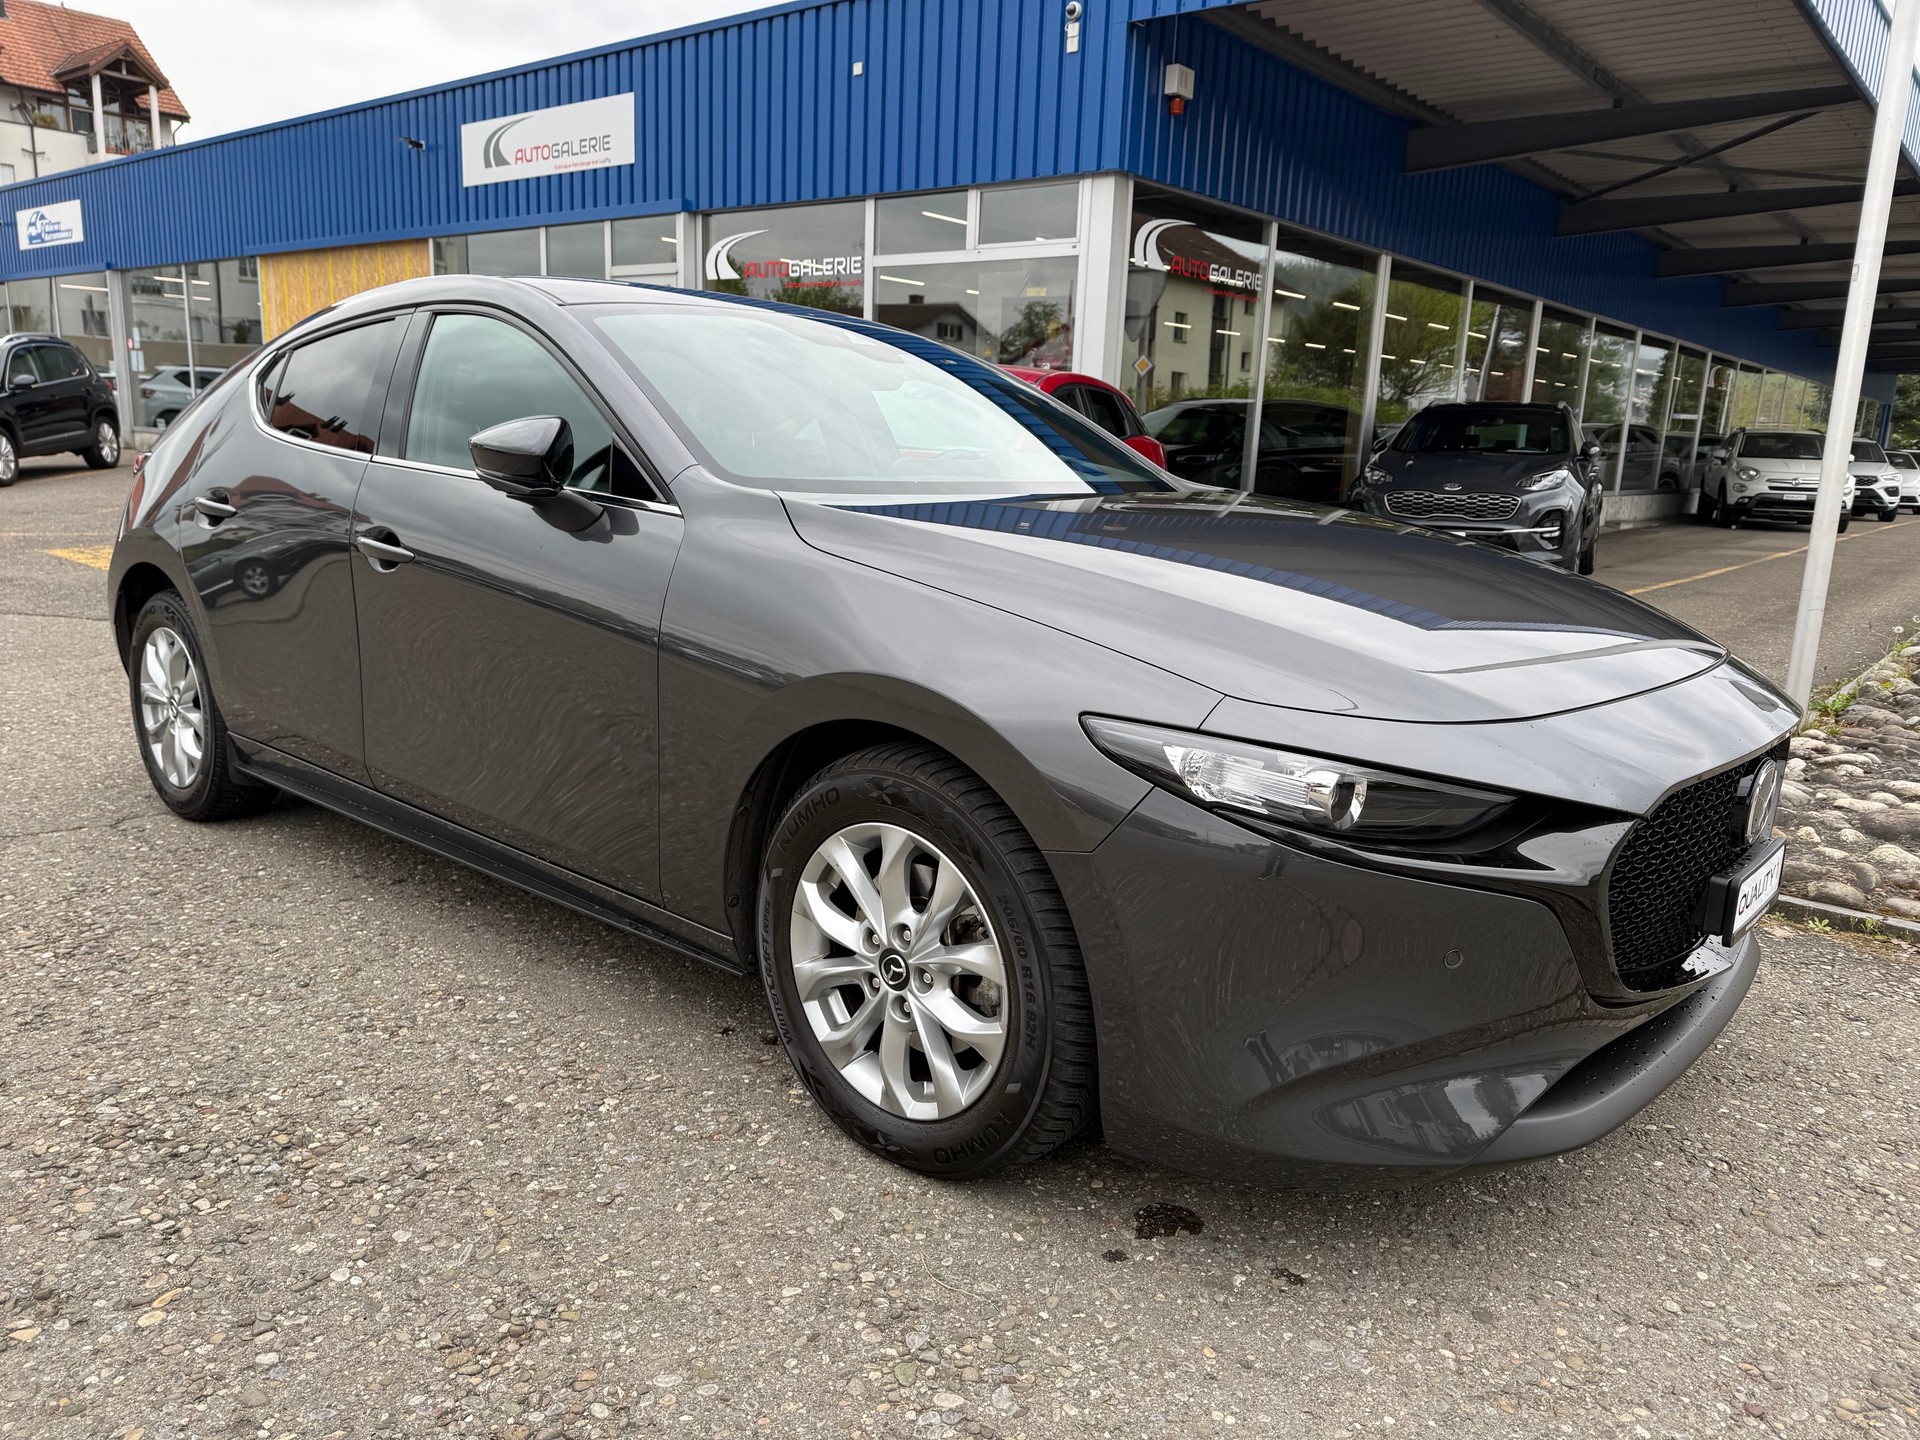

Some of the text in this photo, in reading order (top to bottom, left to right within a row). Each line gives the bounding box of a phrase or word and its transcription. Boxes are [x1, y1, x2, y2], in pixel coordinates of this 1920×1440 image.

[515, 134, 611, 165] AUTOGALERIE
[743, 255, 862, 279] AUTOGALERIE
[1171, 255, 1263, 291] AUTOGALERIE
[776, 786, 841, 854] KUMHO
[997, 894, 1037, 1051] 205/60 R16 92H
[932, 1109, 1011, 1166] KUMHO
